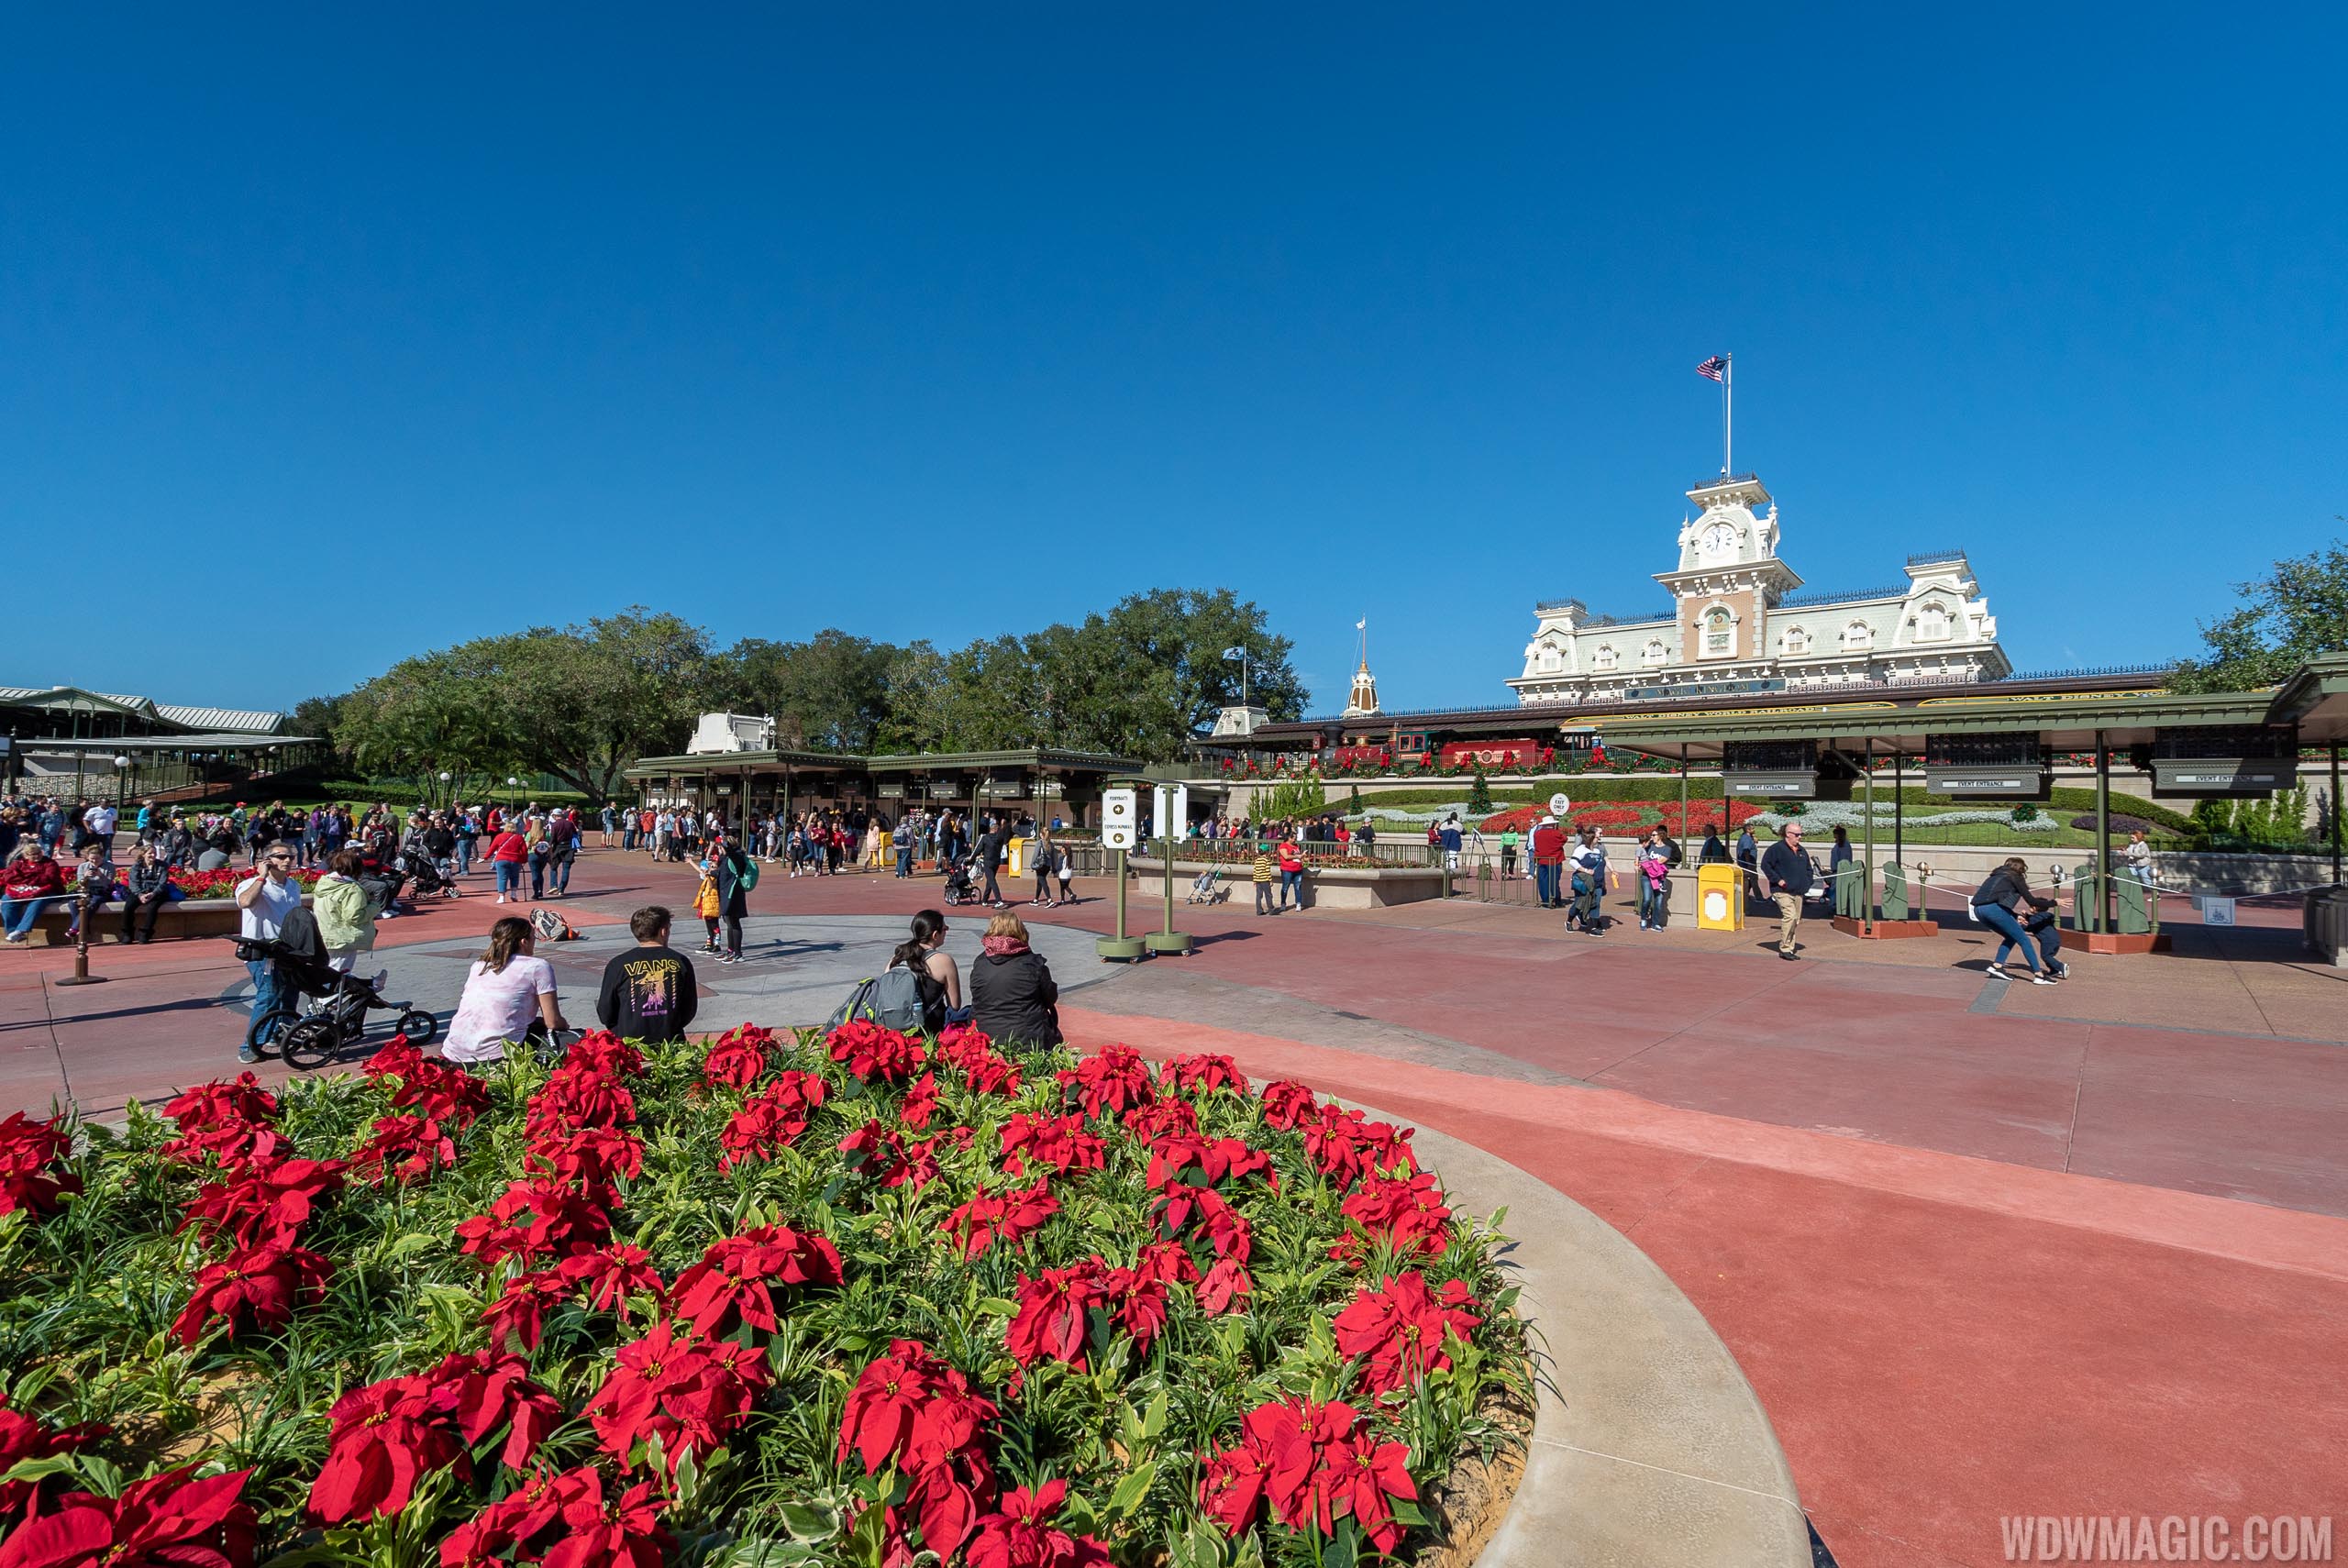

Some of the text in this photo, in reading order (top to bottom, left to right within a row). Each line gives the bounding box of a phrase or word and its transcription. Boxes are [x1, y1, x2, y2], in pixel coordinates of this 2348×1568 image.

[1656, 682, 1750, 696] MAGIC KINGDOM
[1751, 706, 1816, 714] RAILROAD
[625, 959, 681, 977] VANS
